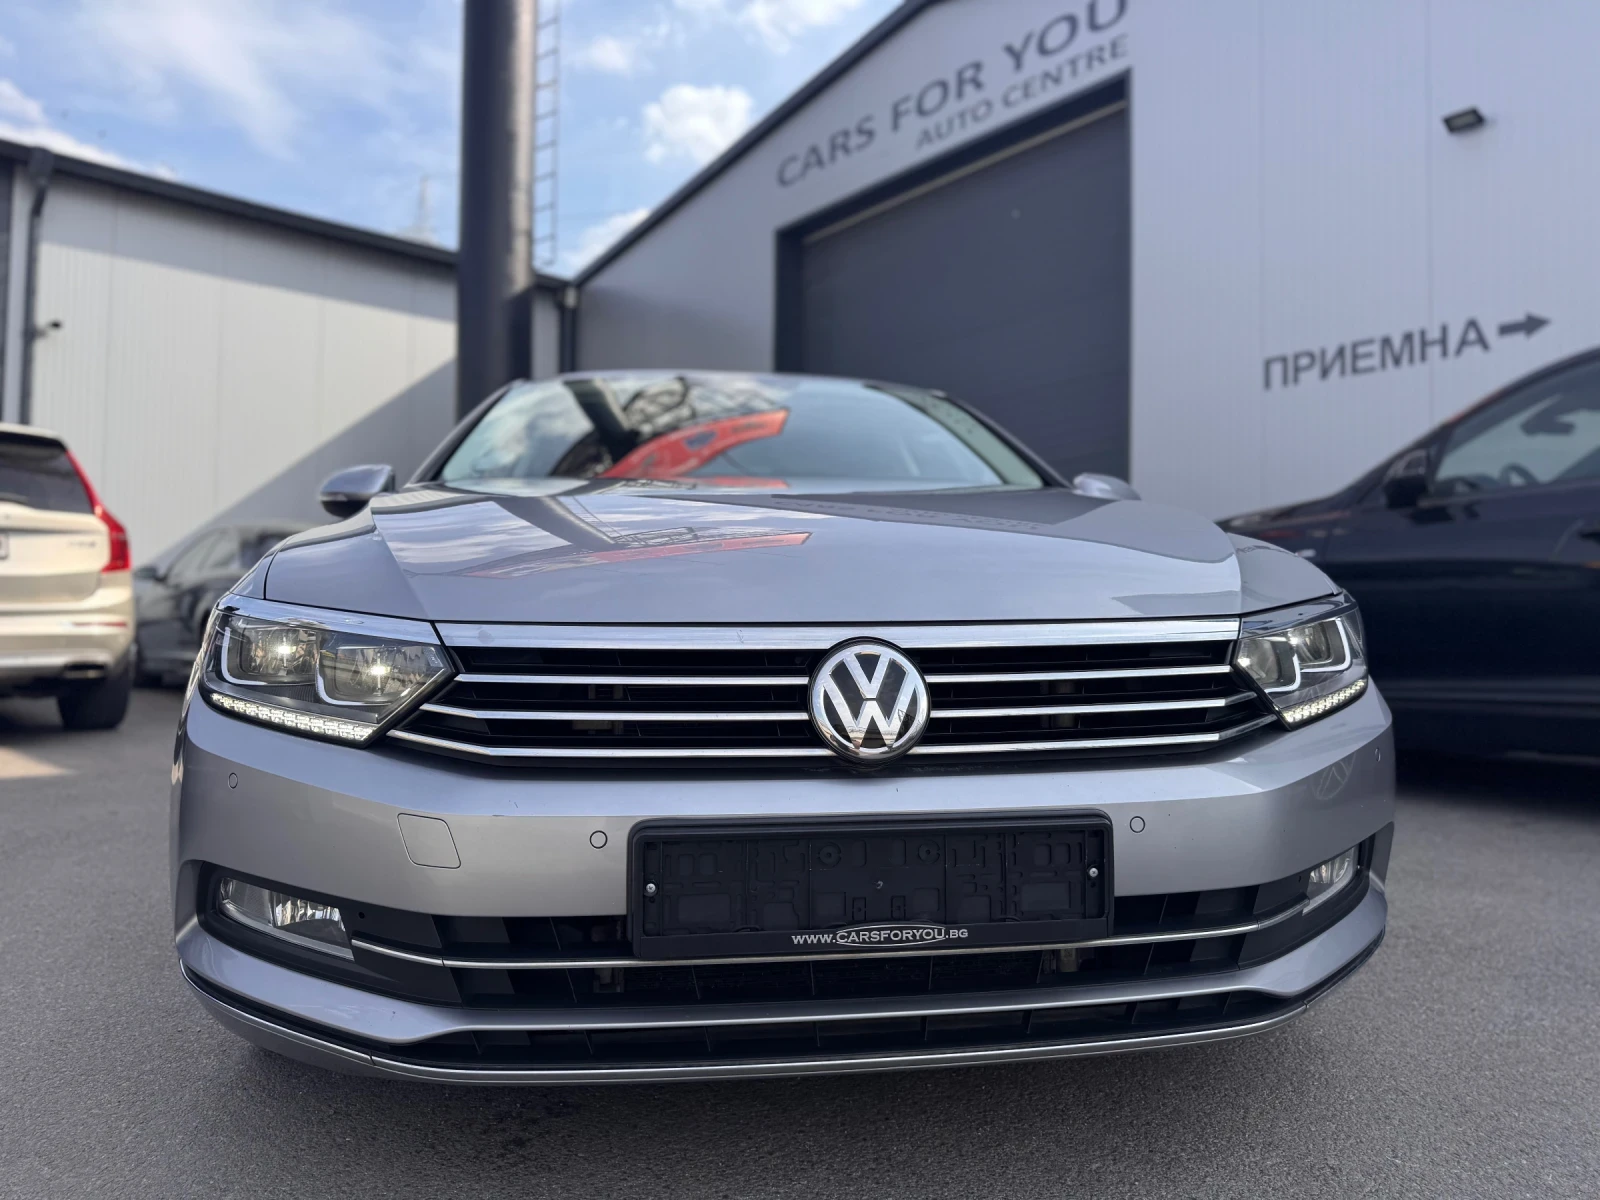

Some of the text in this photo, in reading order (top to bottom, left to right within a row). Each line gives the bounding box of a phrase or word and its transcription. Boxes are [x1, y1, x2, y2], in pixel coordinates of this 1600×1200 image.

[775, 0, 1129, 188] CARS FOR YOU
[914, 33, 1130, 151] AUTO CENTRE
[1263, 317, 1491, 391] ПРИЕМНА
